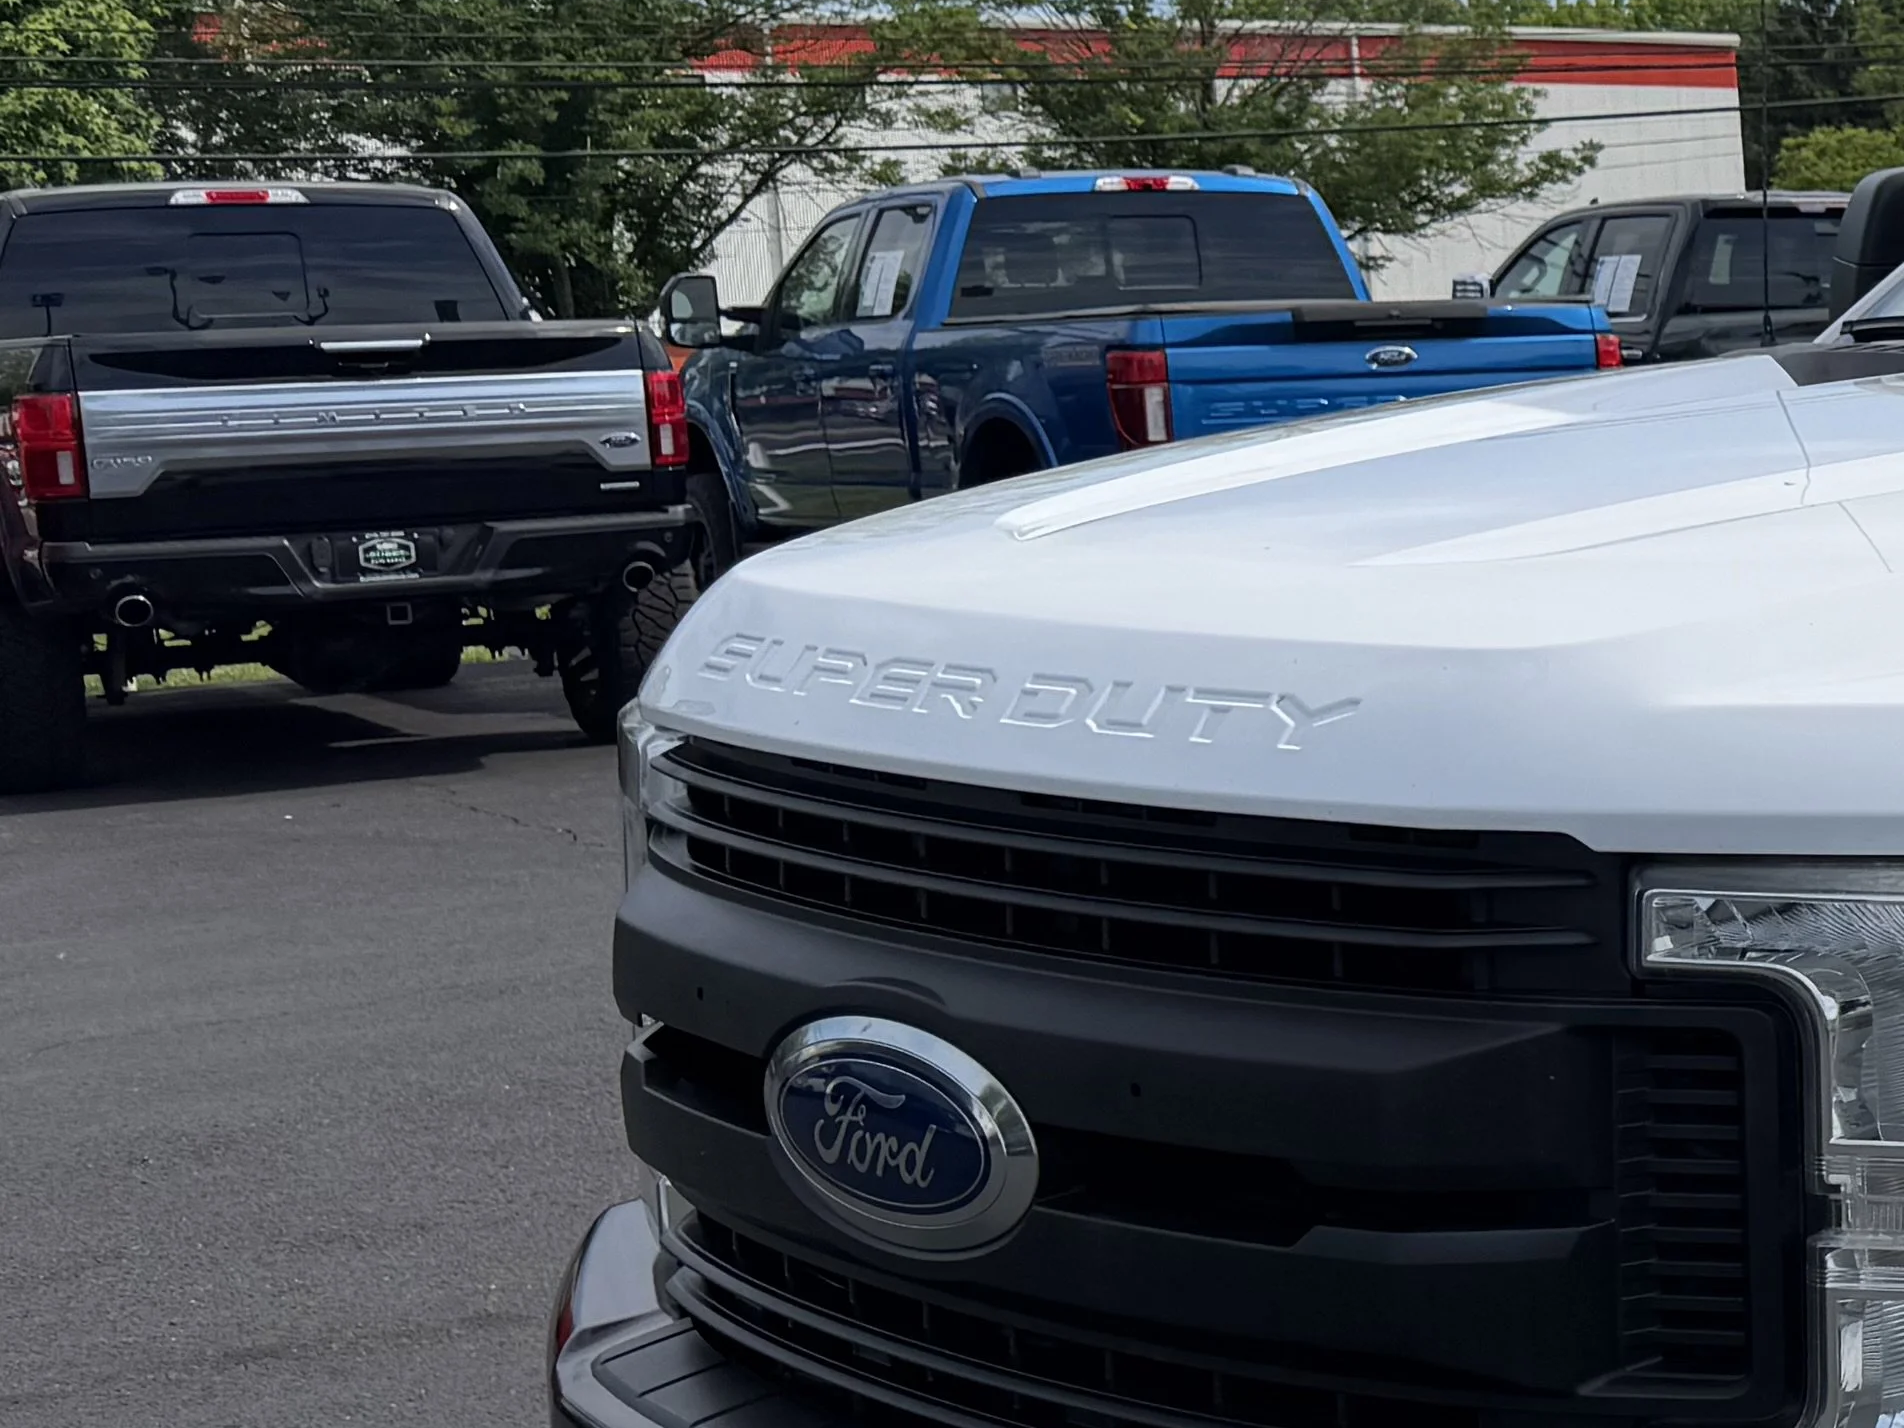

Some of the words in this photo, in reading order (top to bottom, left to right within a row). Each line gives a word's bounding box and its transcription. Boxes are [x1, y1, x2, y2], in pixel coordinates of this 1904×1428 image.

[699, 632, 997, 719] SUPER
[1000, 672, 1362, 750] DUTY
[814, 1075, 937, 1189] Ford
